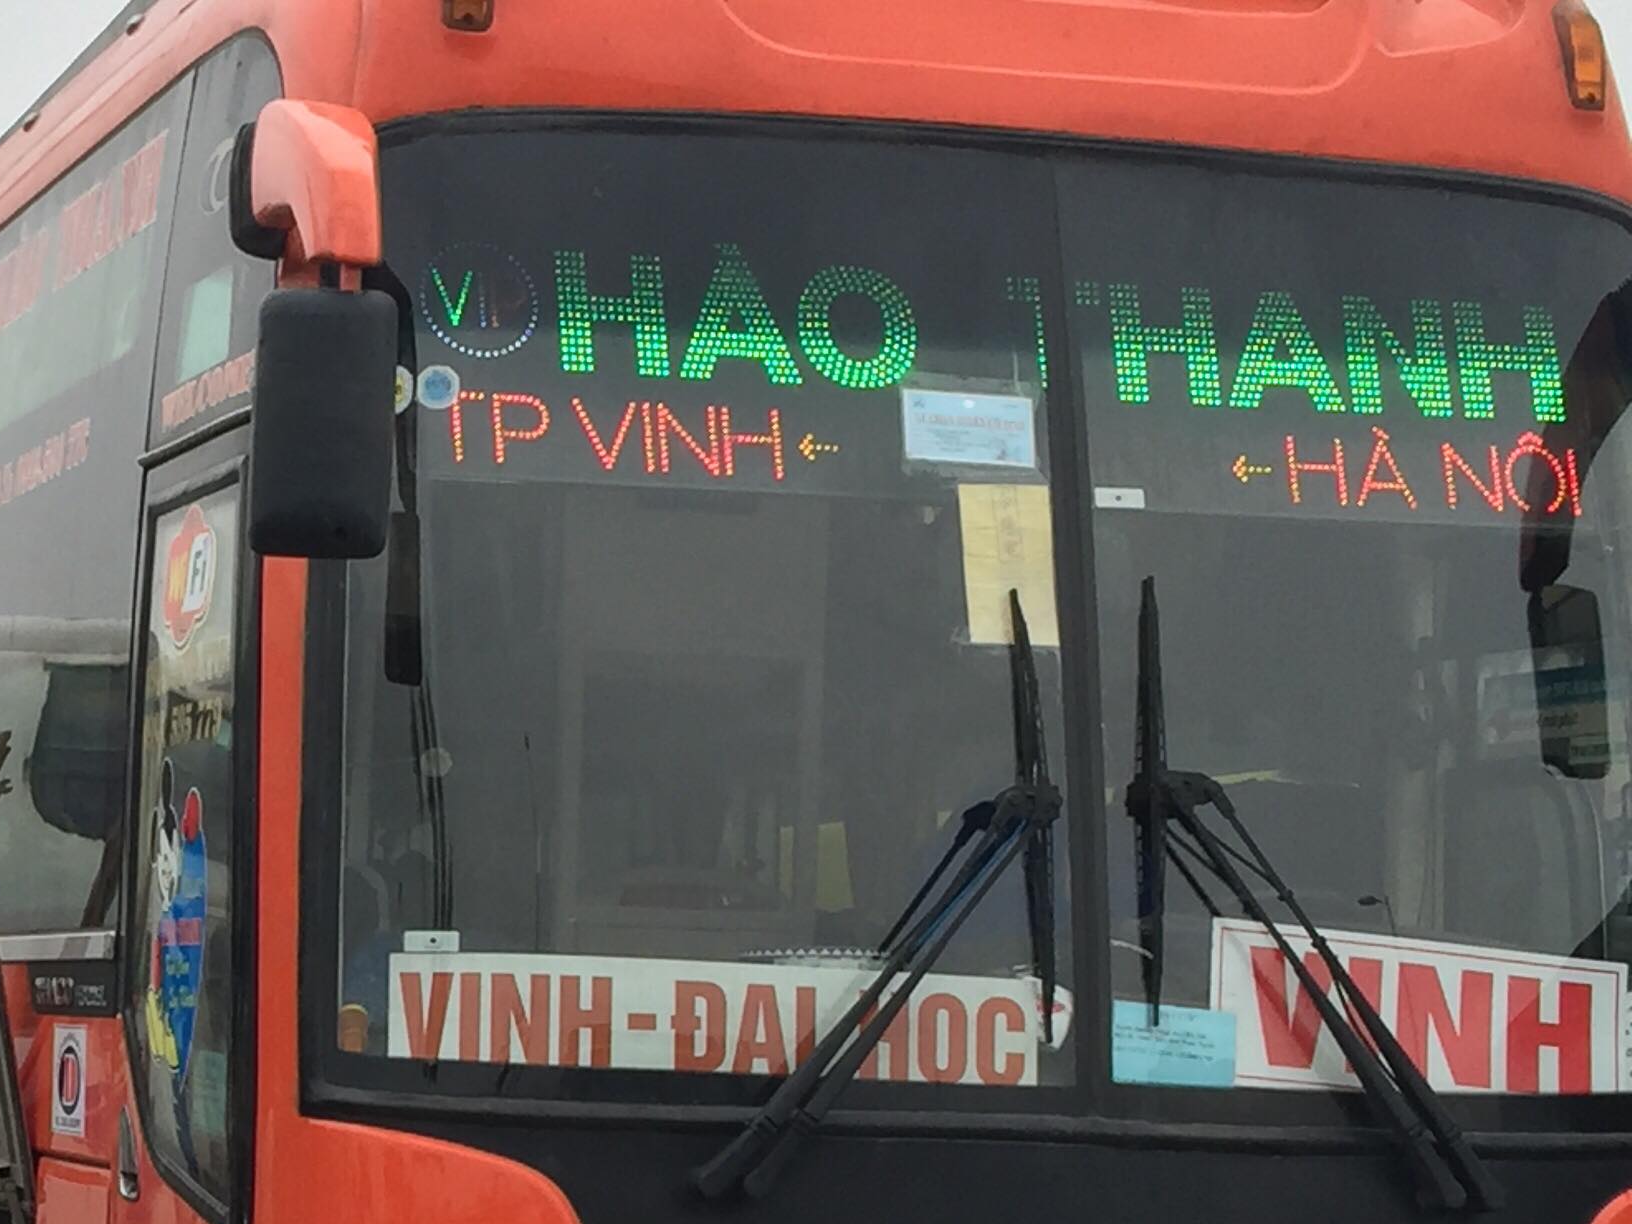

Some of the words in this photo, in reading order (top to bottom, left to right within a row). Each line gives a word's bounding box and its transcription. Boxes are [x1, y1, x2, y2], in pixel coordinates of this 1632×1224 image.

[450, 388, 552, 464] TP
[571, 396, 786, 480] VINH
[1283, 424, 1417, 510] HÀ
